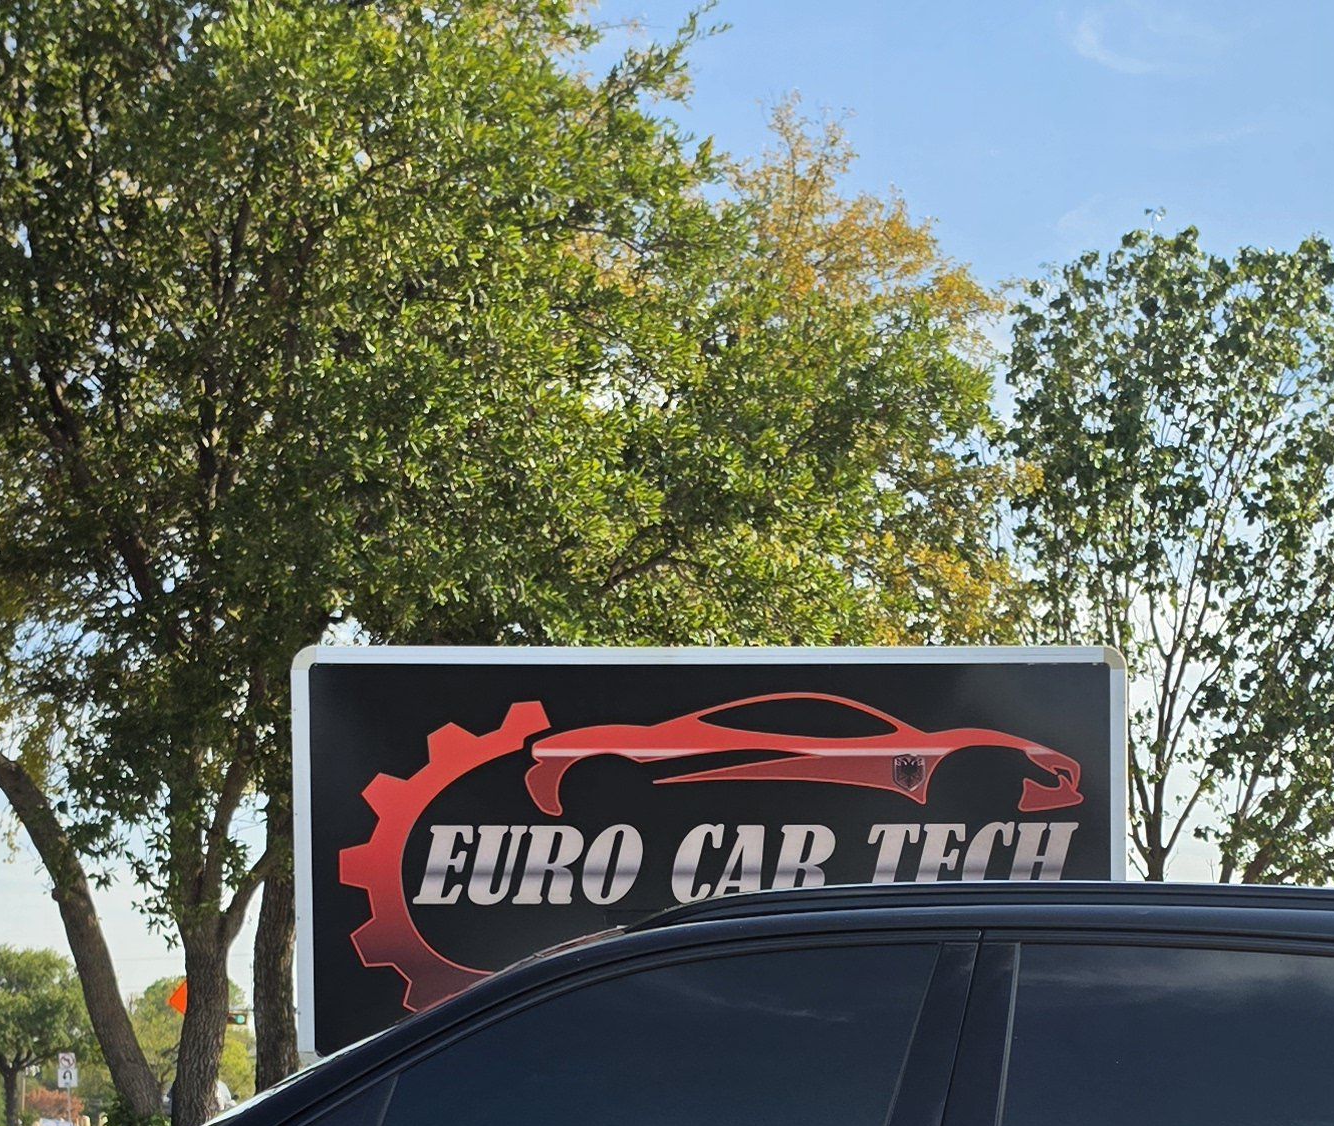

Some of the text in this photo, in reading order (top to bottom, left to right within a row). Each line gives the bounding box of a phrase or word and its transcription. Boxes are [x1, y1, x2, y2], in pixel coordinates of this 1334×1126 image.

[413, 821, 1079, 905] EURO CAR TECH
